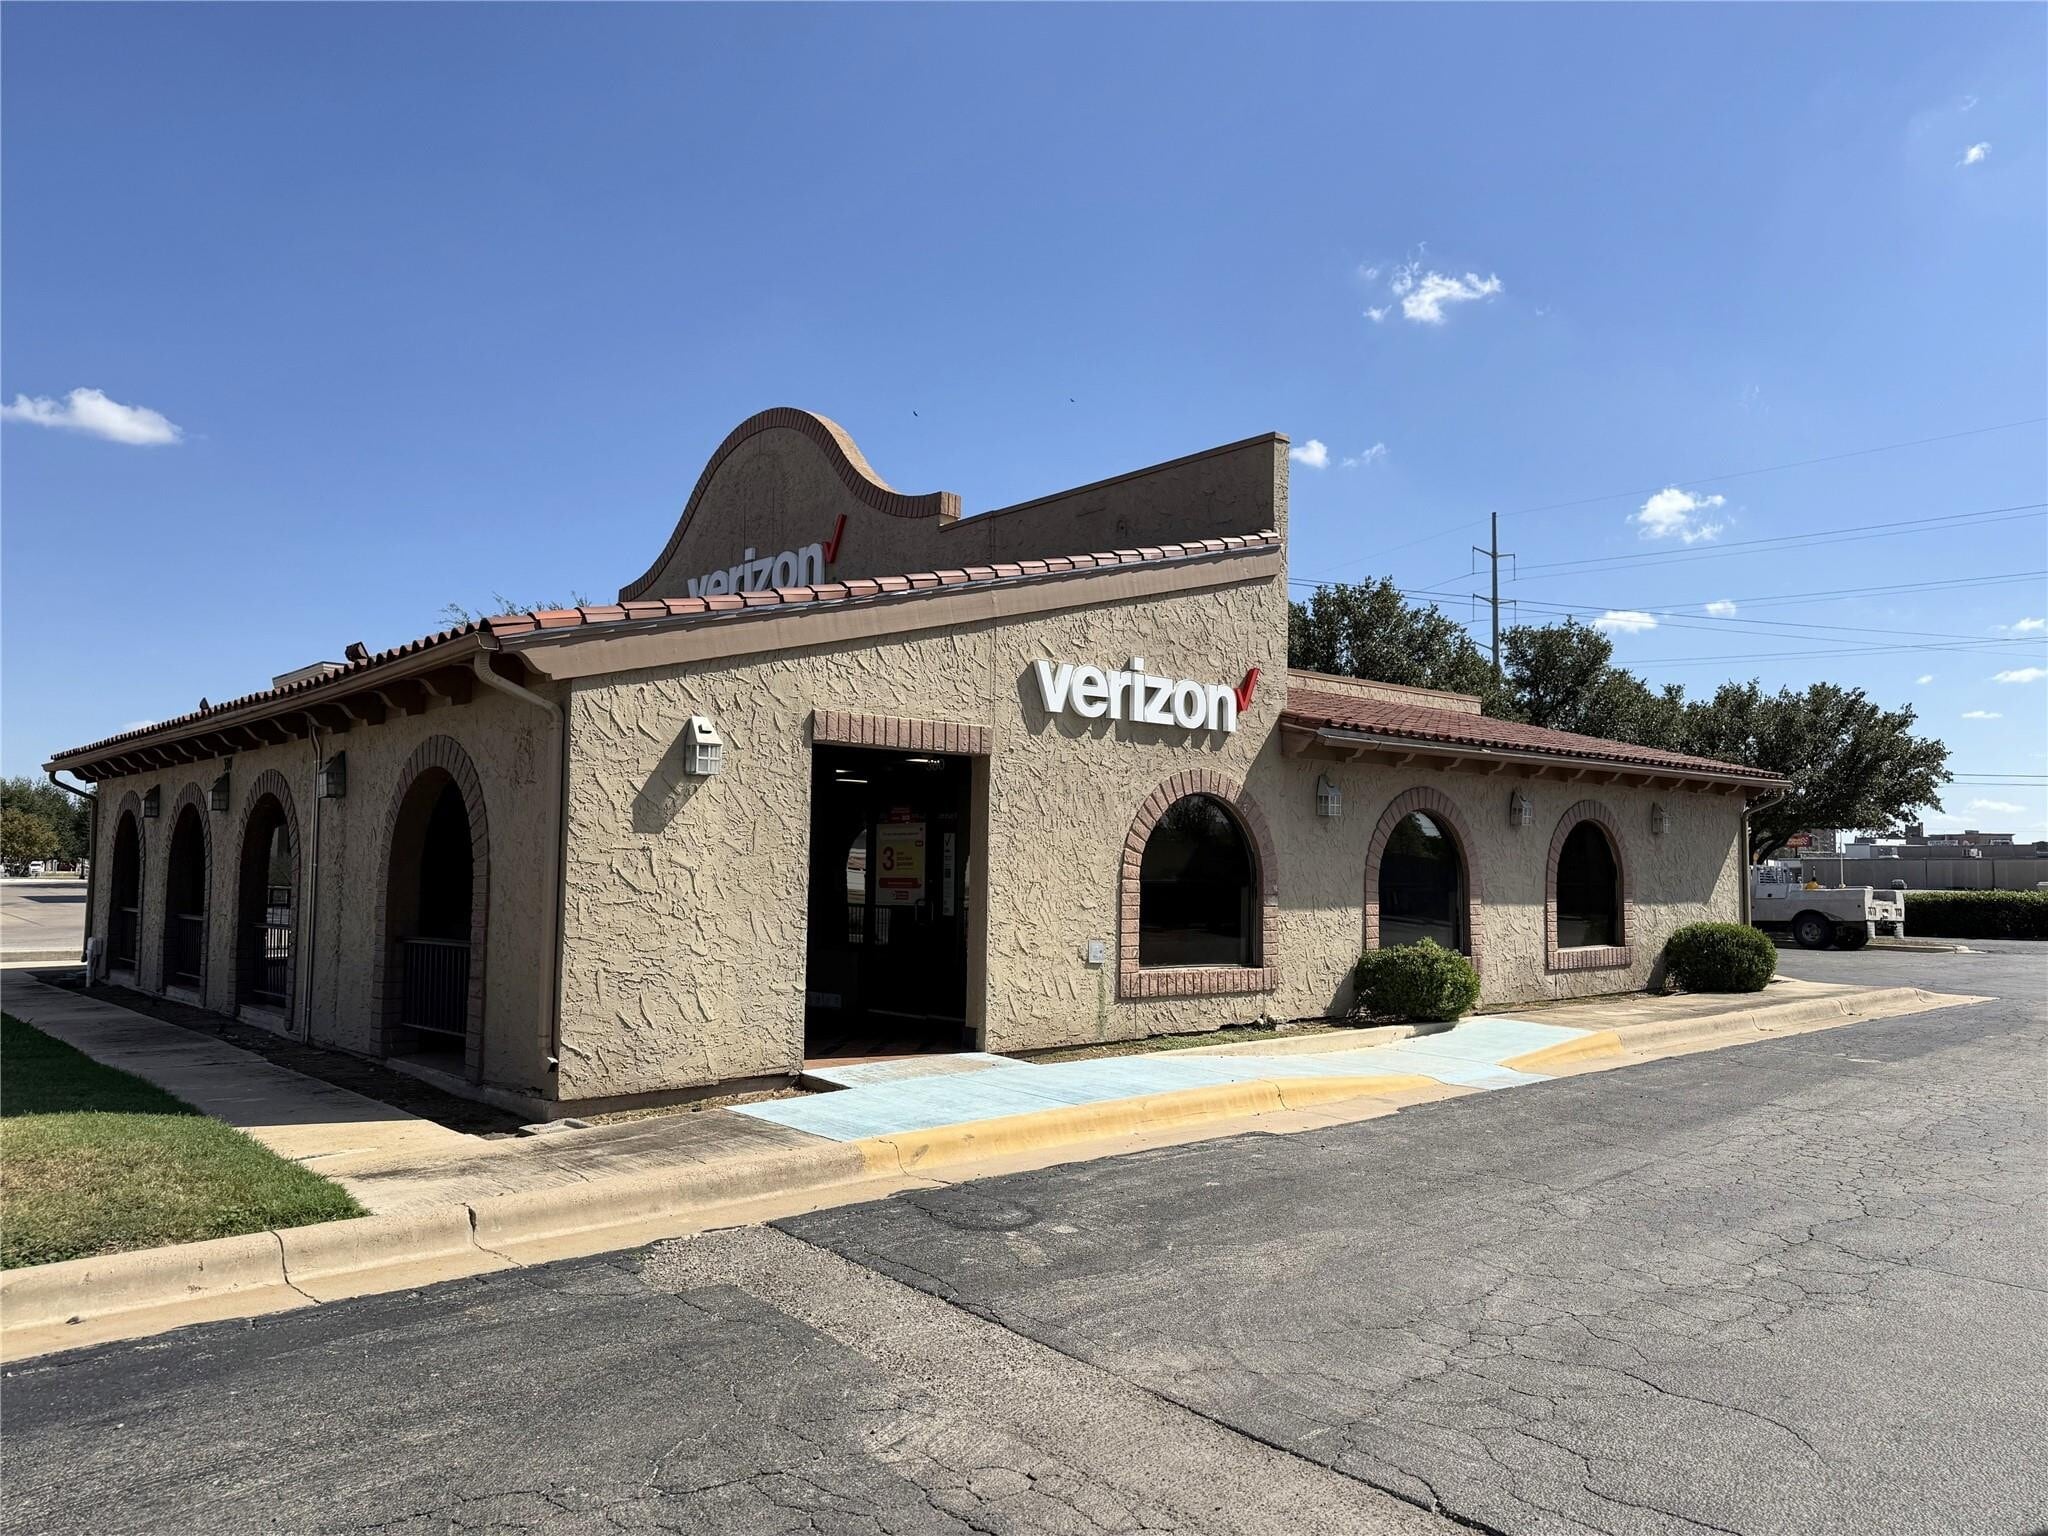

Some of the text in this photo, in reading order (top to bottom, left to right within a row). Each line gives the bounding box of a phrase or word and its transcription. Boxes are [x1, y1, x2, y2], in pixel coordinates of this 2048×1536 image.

[688, 543, 825, 598] verizon
[1031, 656, 1238, 733] verizon
[883, 846, 894, 870] 3
